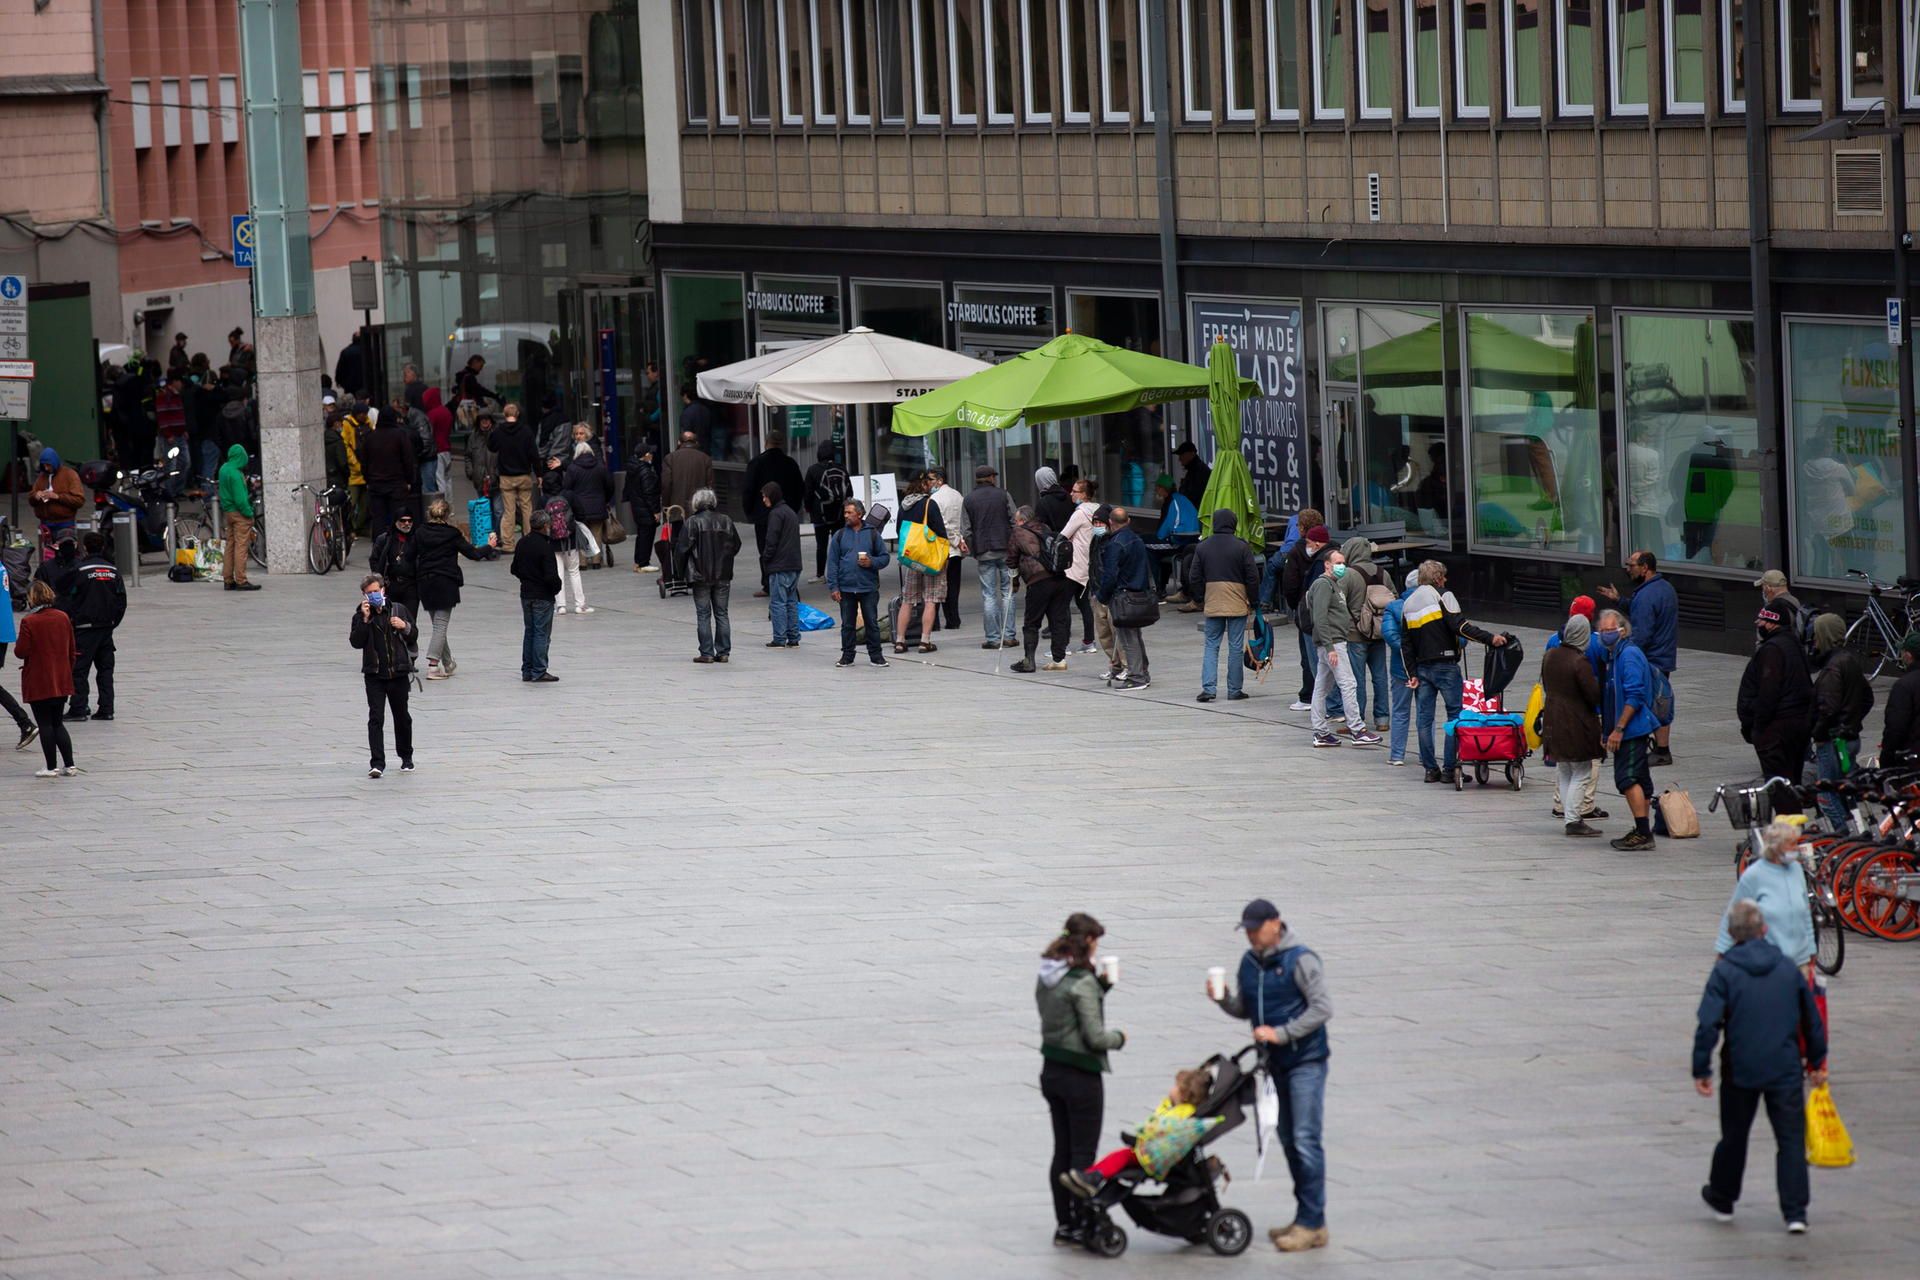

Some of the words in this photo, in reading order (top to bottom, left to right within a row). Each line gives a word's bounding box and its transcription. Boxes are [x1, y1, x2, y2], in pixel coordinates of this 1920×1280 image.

[237, 251, 252, 262] TA
[747, 292, 793, 312] STARBUCKS
[794, 295, 825, 313] COFFEE
[948, 302, 999, 324] STARBUCKS
[1002, 306, 1037, 325] COFFEE
[1202, 323, 1248, 349] FRESH
[1254, 326, 1295, 352] MADE
[1255, 400, 1263, 435] &
[1265, 400, 1298, 438] CURRIES
[1287, 441, 1299, 478] &
